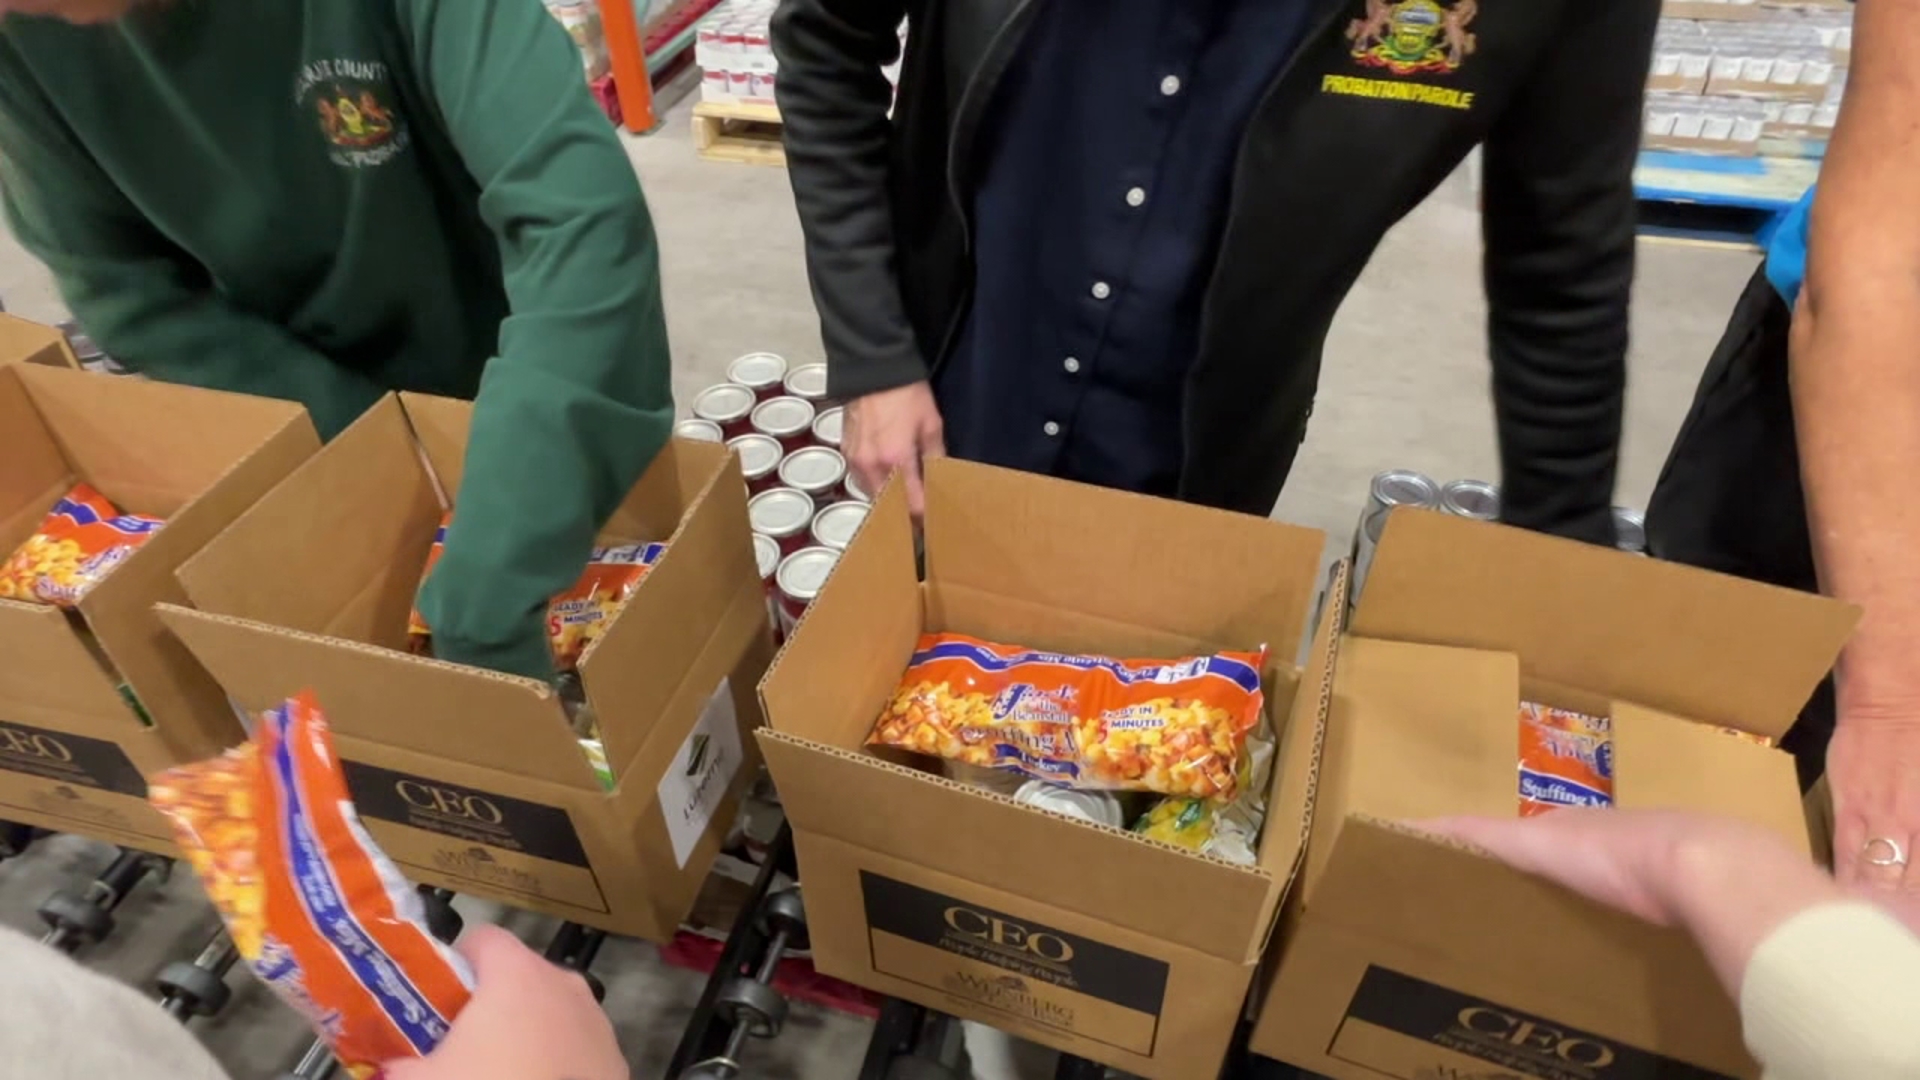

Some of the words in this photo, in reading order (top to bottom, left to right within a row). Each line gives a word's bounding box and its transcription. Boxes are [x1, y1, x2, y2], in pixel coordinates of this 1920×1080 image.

[1110, 718, 1165, 729] MINUTES
[1139, 706, 1153, 715] IN
[395, 779, 503, 825] CEO
[1521, 778, 1587, 807] Stuffing
[943, 905, 1075, 963] CEO
[1457, 1006, 1616, 1070] CEO
